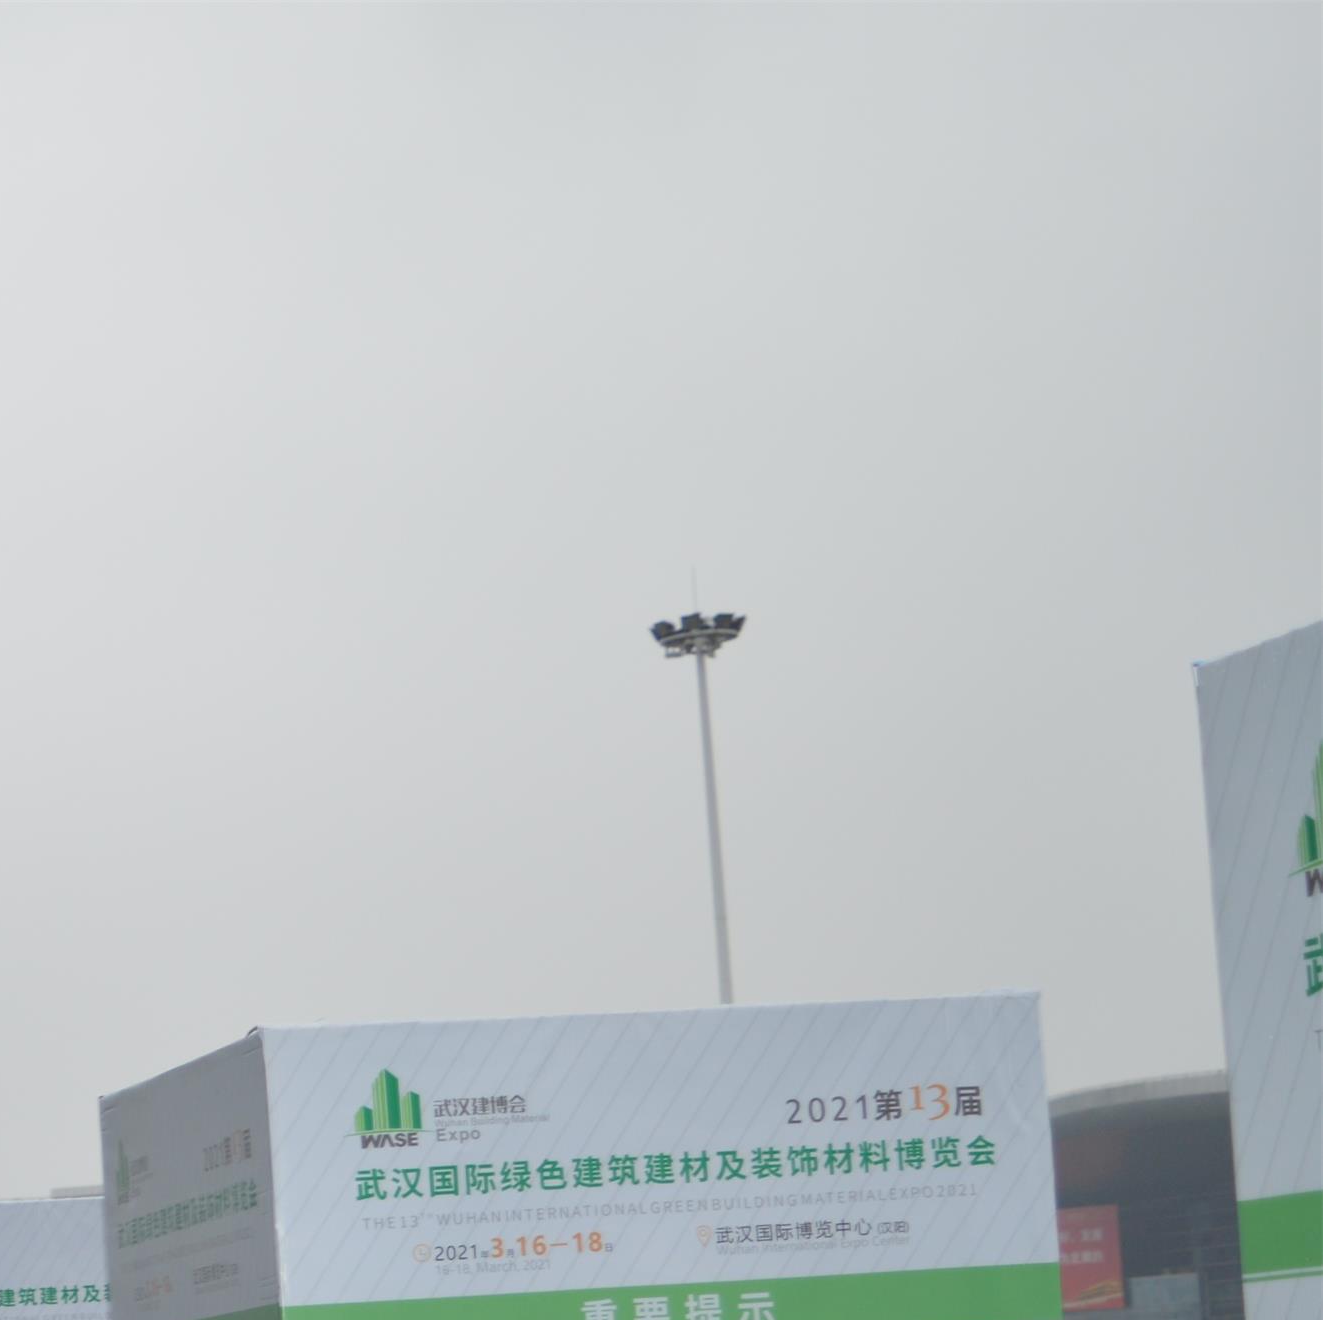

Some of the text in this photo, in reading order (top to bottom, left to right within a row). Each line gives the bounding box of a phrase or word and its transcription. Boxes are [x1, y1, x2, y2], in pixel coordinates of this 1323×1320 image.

[433, 1095, 527, 1119] 武汉建博会
[785, 1083, 983, 1125] 2021第13届
[360, 1132, 420, 1150] WASE
[436, 1128, 482, 1144] Expo
[355, 1134, 997, 1201] 武汉国际绿色建筑建材及装饰材料博览会
